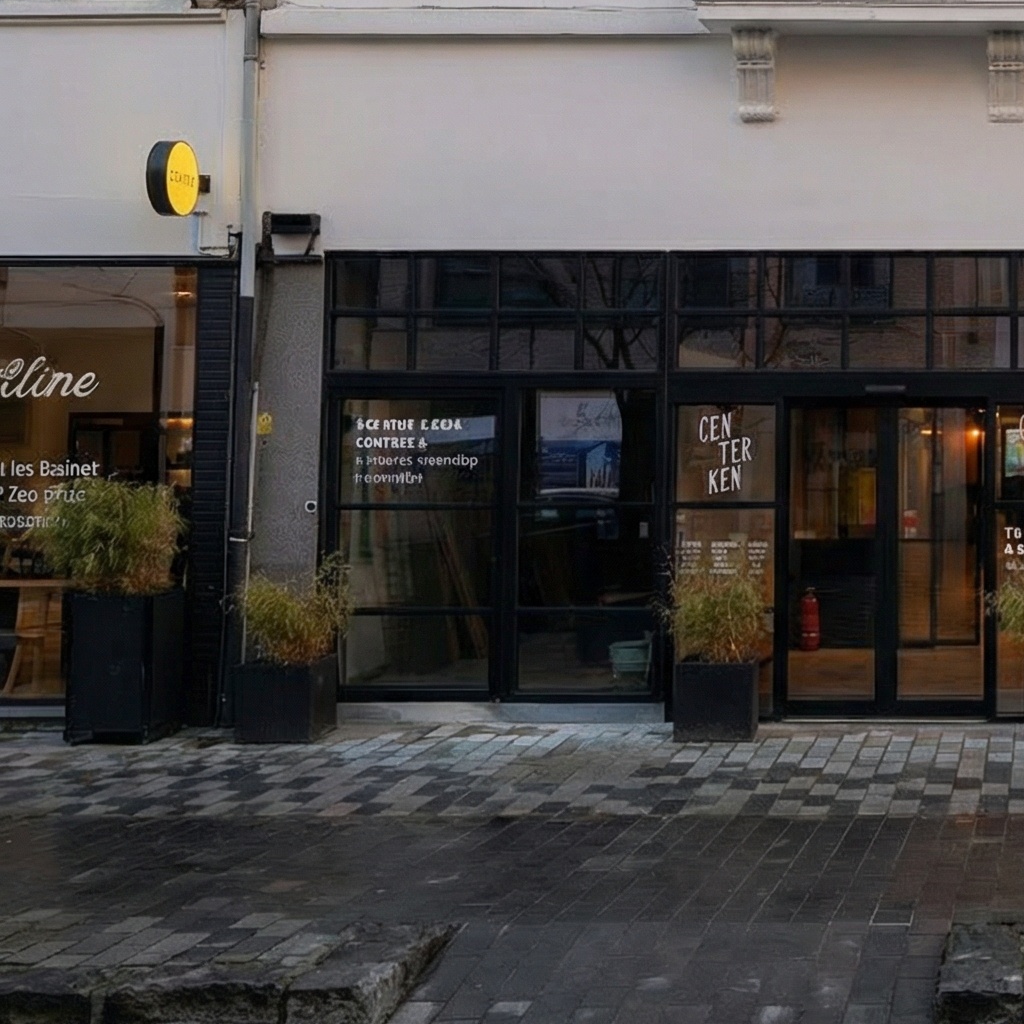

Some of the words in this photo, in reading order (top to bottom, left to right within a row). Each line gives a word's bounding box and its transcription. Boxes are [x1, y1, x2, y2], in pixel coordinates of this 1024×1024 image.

[699, 412, 731, 442] CEN
[718, 437, 752, 465] TER
[11, 459, 35, 477] les
[708, 465, 742, 494] KEN
[8, 485, 39, 503] Zeo
